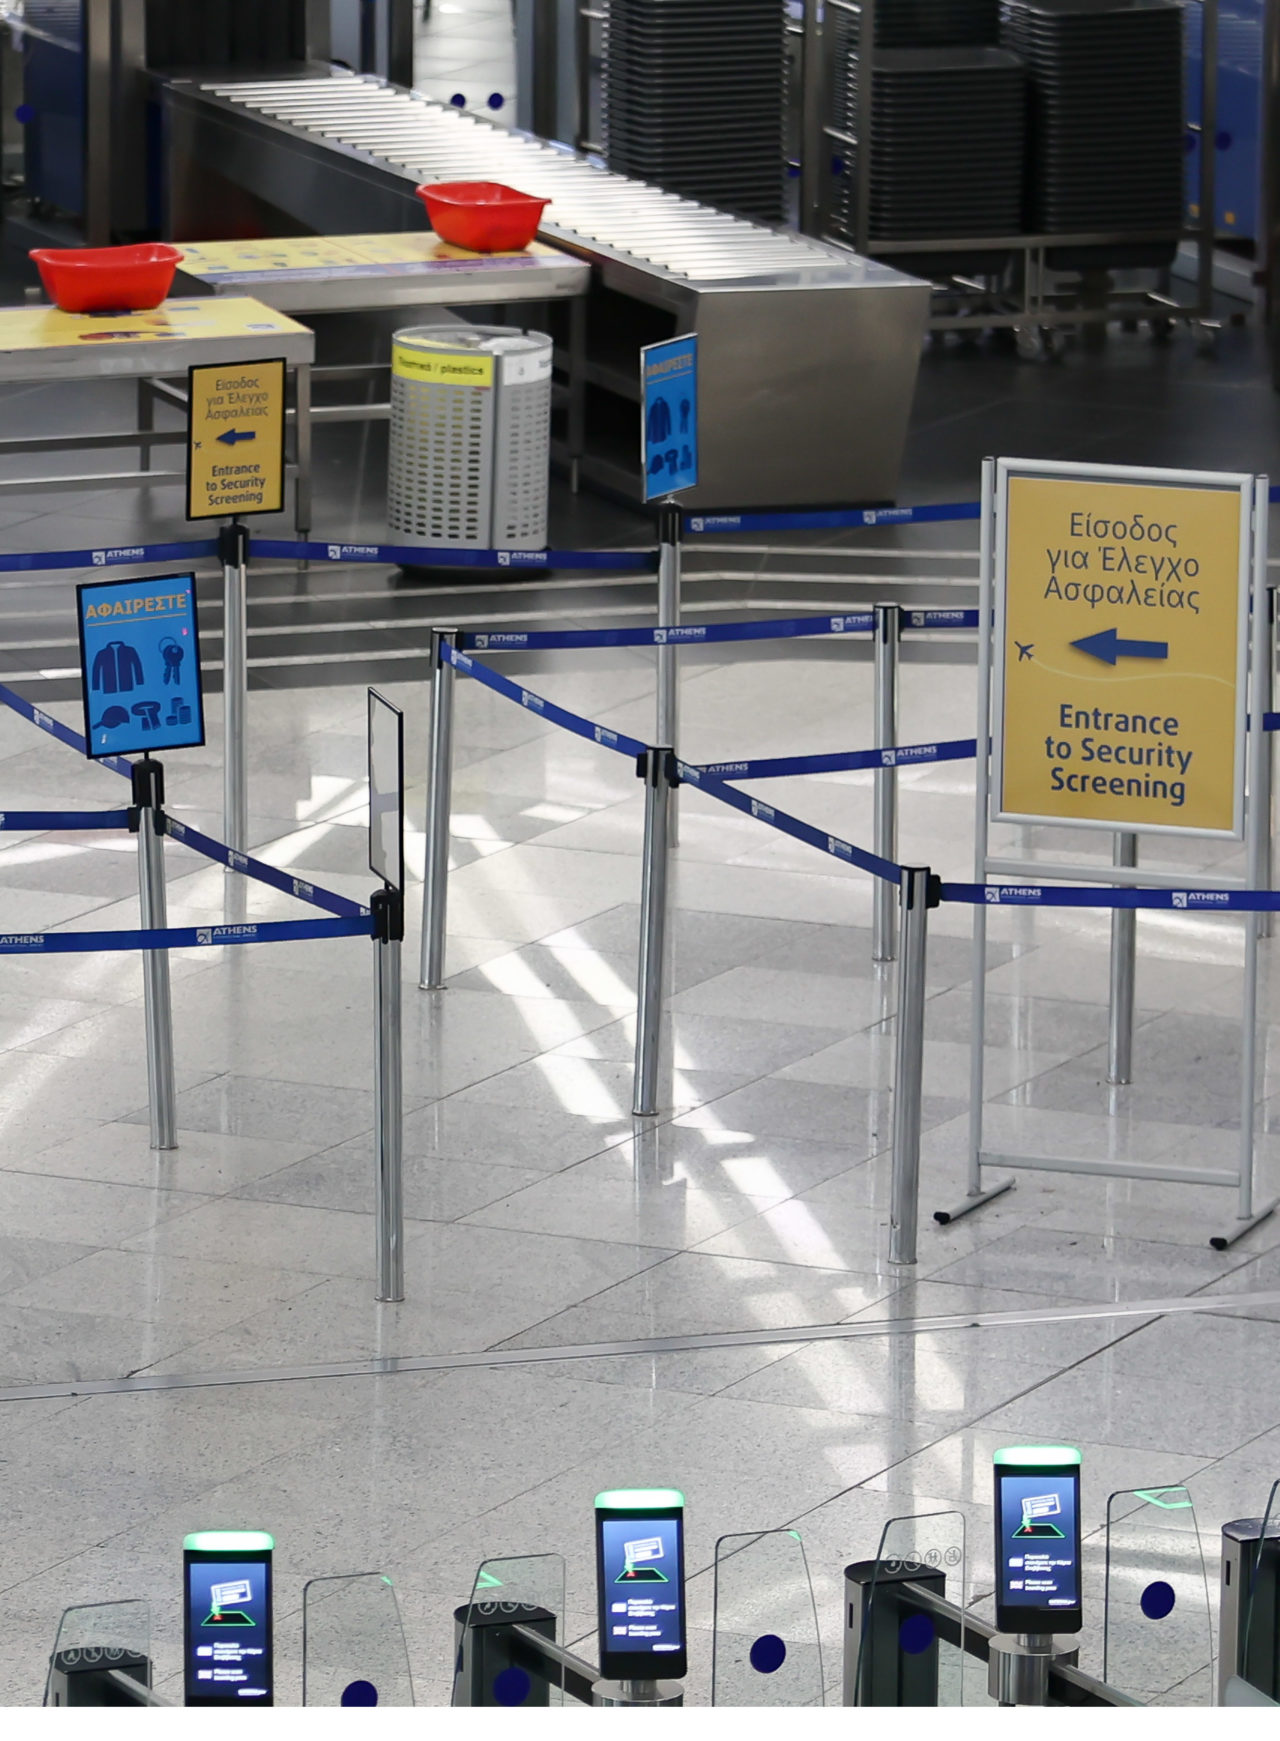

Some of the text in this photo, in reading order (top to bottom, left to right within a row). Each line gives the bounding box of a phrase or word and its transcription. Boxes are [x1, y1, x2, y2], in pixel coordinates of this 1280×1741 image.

[211, 464, 261, 477] Entrance
[206, 476, 266, 492] to Security
[208, 491, 263, 506] Screening
[1070, 512, 1178, 548] Είσοδος
[106, 548, 144, 557] ATHENS
[341, 546, 378, 555] ATHENS
[511, 551, 548, 561] ATHENS
[1046, 546, 1200, 583] για Έλεγχο
[1044, 575, 1200, 614] Ασφαλείας
[85, 593, 187, 620] ΑΦΑΙΡΕΣΤΕ
[845, 615, 873, 624] ATHE
[925, 611, 965, 621] ATHENS
[668, 627, 706, 637] ATHENS
[489, 633, 528, 643] ATHENS
[1059, 703, 1179, 737] Entrance
[896, 746, 937, 757] ATHENS
[1045, 736, 1193, 775] to Security
[707, 762, 748, 773] ATHENS
[1051, 767, 1186, 807] Screening
[1000, 887, 1041, 898] ATHENS
[1188, 892, 1229, 902] ATHENS
[212, 925, 258, 936] ATHENS
[0, 935, 45, 945] ATHENS
